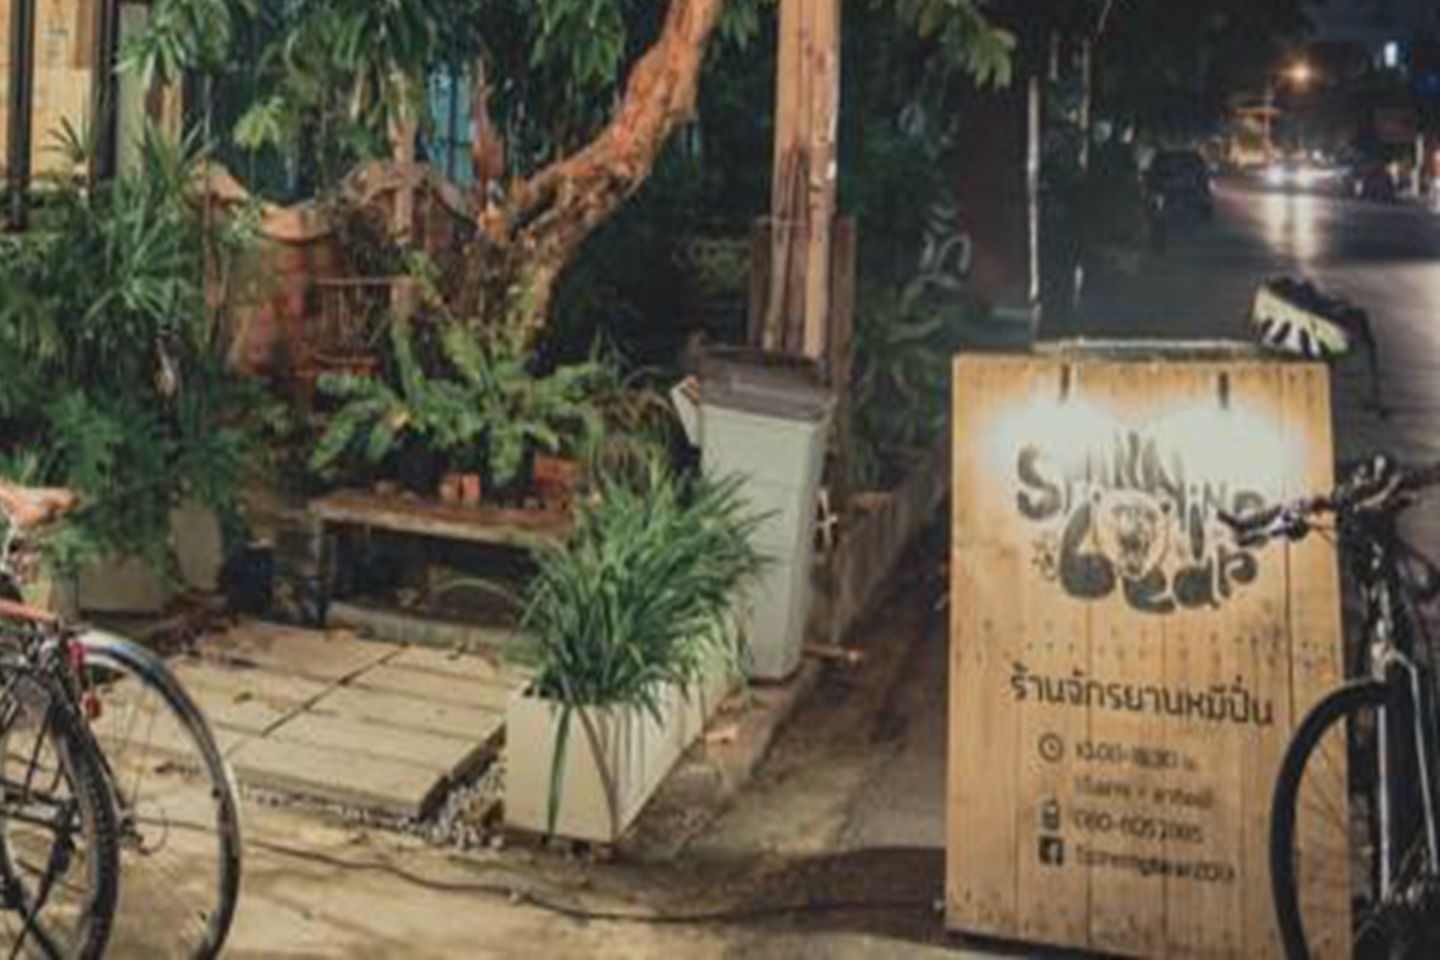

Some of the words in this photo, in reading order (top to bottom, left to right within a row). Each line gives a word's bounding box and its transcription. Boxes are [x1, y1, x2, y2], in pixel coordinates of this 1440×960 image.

[1011, 661, 1273, 726] ร้านจักรยานหมีปั่น
